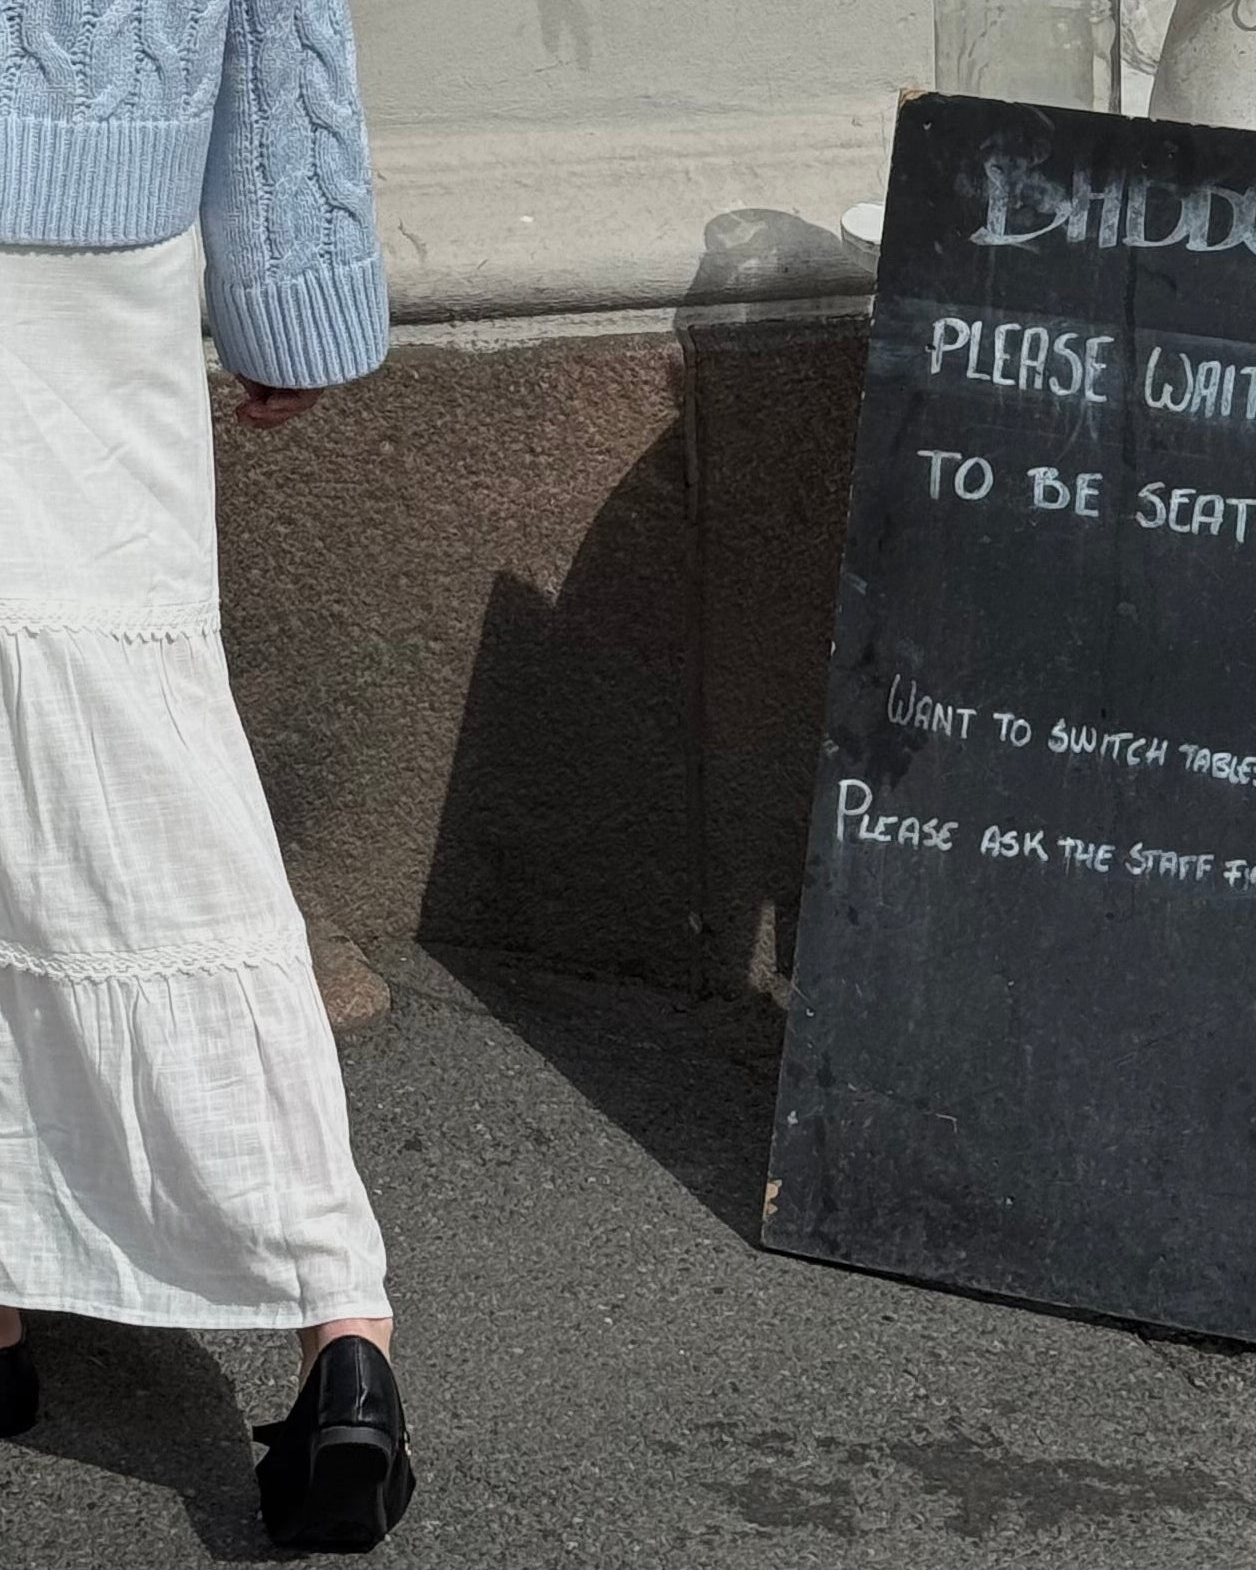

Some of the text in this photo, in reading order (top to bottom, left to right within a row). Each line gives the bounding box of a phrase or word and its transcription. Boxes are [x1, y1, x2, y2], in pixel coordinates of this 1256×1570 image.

[926, 317, 1256, 420] PLEASE WAIT
[917, 449, 1256, 544] TO BE SEAT
[887, 673, 978, 739] WANT
[993, 712, 1032, 748] TO
[1047, 718, 1169, 766] SWITCH
[837, 778, 960, 851] PLEASE
[980, 825, 1049, 862] ASK
[1057, 836, 1116, 874] THE
[1125, 842, 1215, 881] STAFF
